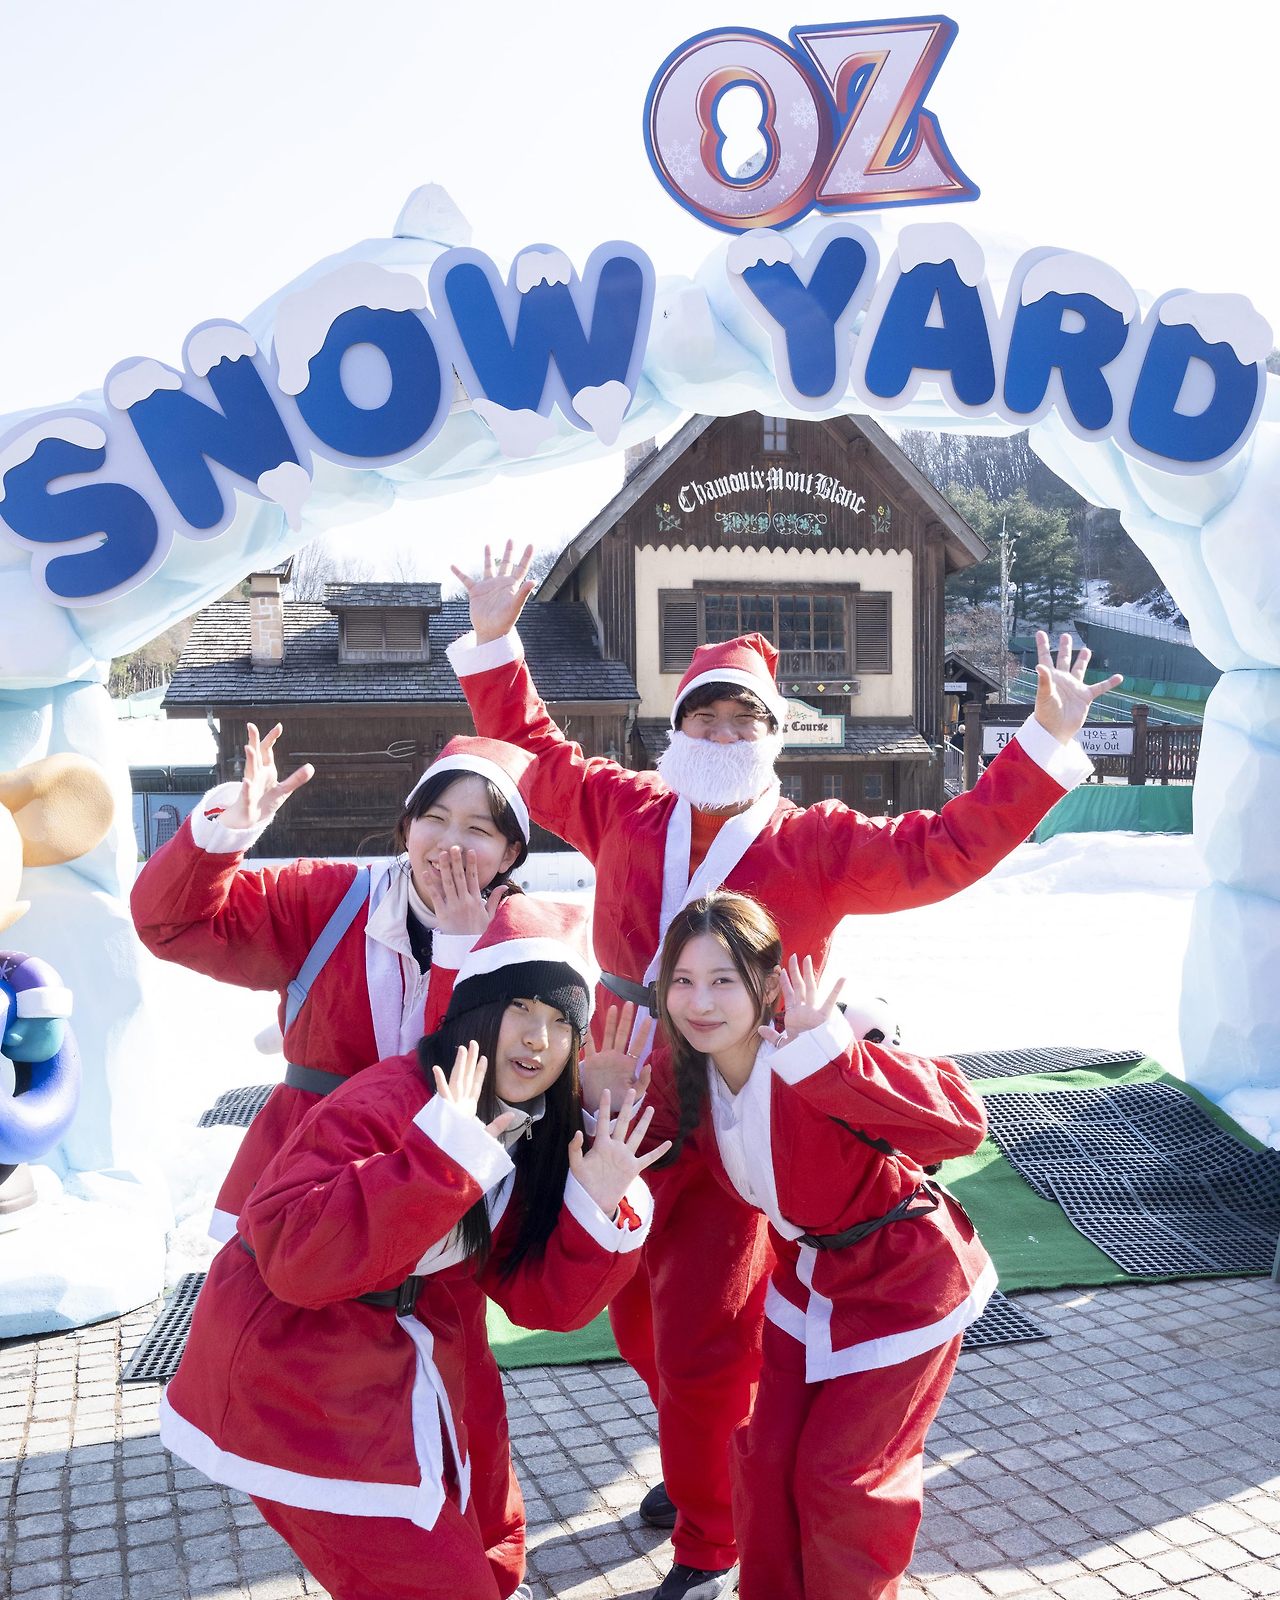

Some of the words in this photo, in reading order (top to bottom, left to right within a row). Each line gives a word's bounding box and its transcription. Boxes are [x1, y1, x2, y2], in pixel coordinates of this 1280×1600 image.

[643, 14, 980, 235] OZ
[0, 250, 648, 602] SNOW
[735, 230, 1264, 468] YARD
[677, 465, 765, 513] Chamonix
[765, 466, 815, 494] Mont
[813, 472, 867, 515] Blanc
[791, 721, 829, 732] Course
[1083, 730, 1107, 740] 나오는
[1110, 730, 1118, 740] 곳
[1082, 741, 1101, 752] Way
[1103, 741, 1120, 750] Out
